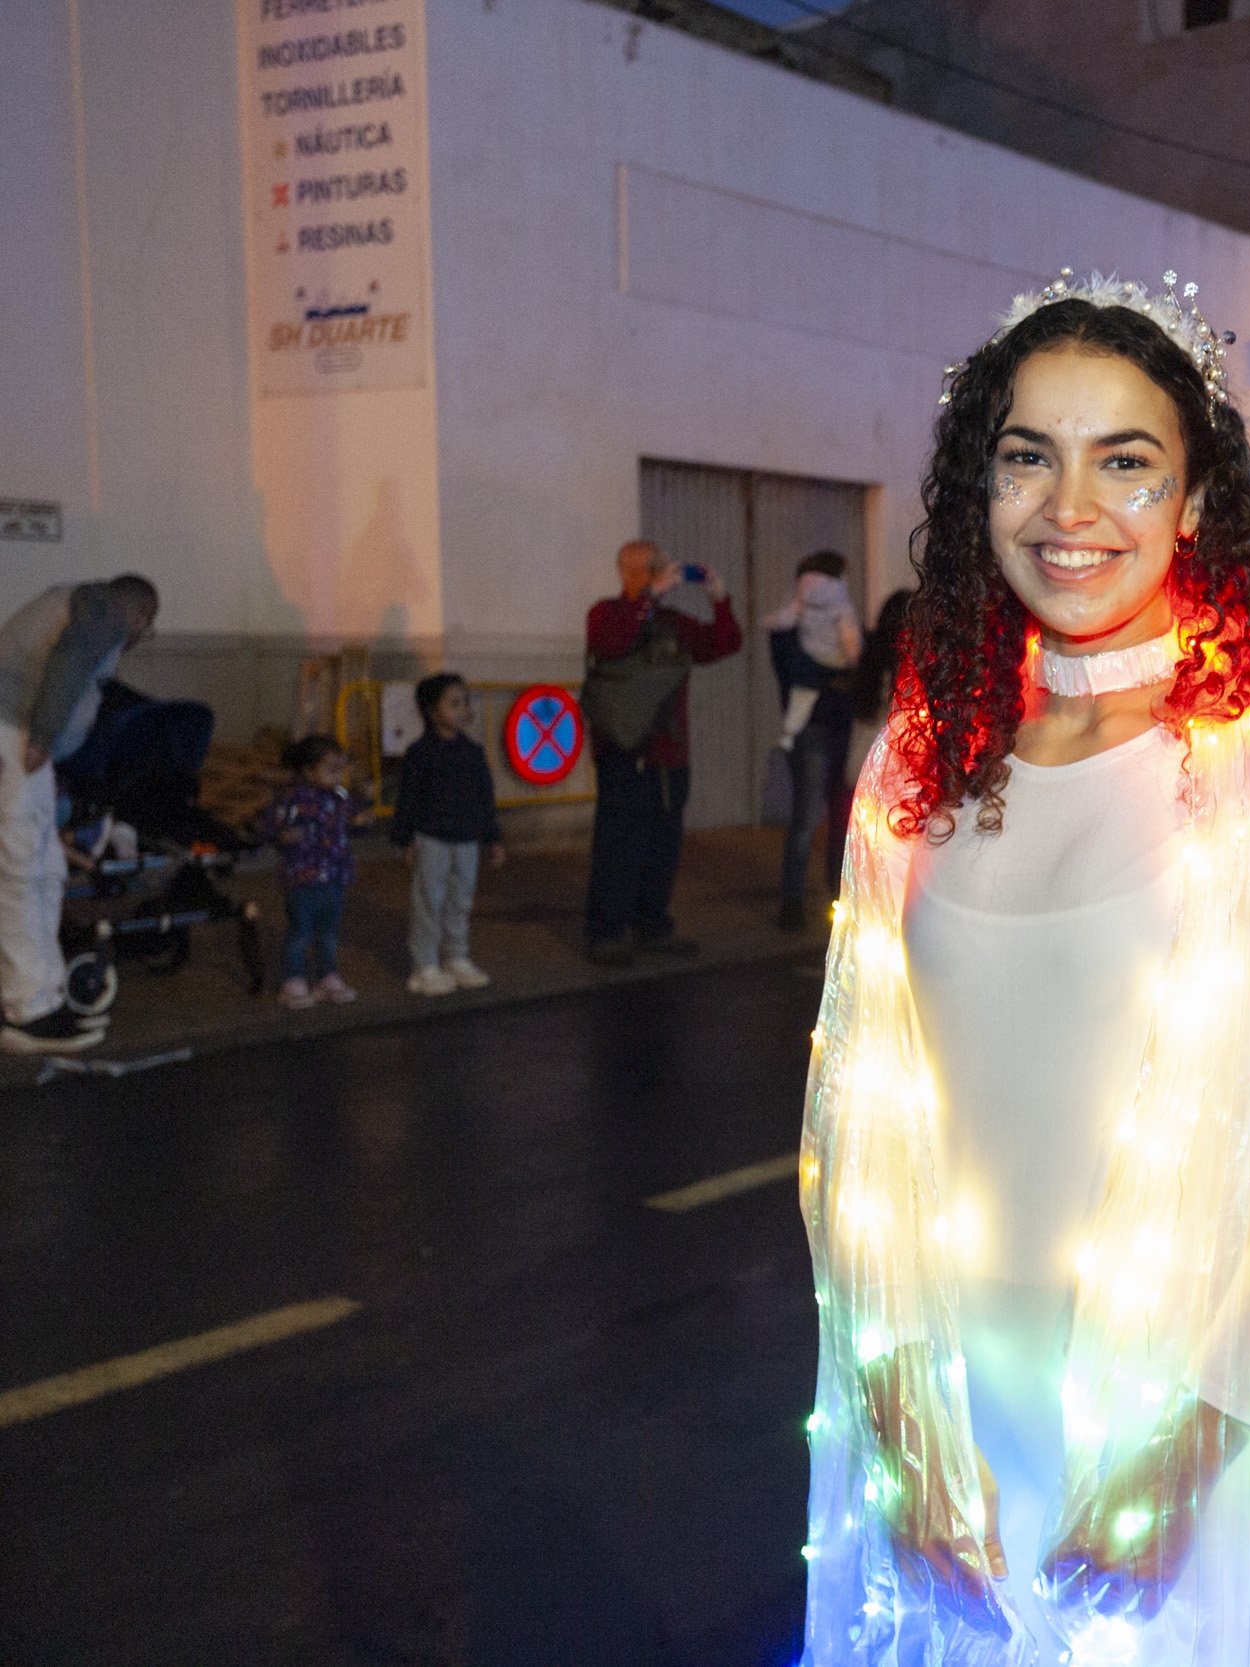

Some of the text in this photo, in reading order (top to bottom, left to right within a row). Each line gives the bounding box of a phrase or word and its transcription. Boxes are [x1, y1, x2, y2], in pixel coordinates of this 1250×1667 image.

[257, 22, 406, 69] INOXIDABLES
[261, 66, 405, 117] TORNILLERÍA
[295, 121, 392, 155] NÁUTICA
[296, 166, 408, 203] PINTURAS
[298, 217, 393, 250] RESINAS
[305, 311, 411, 348] DUARTE
